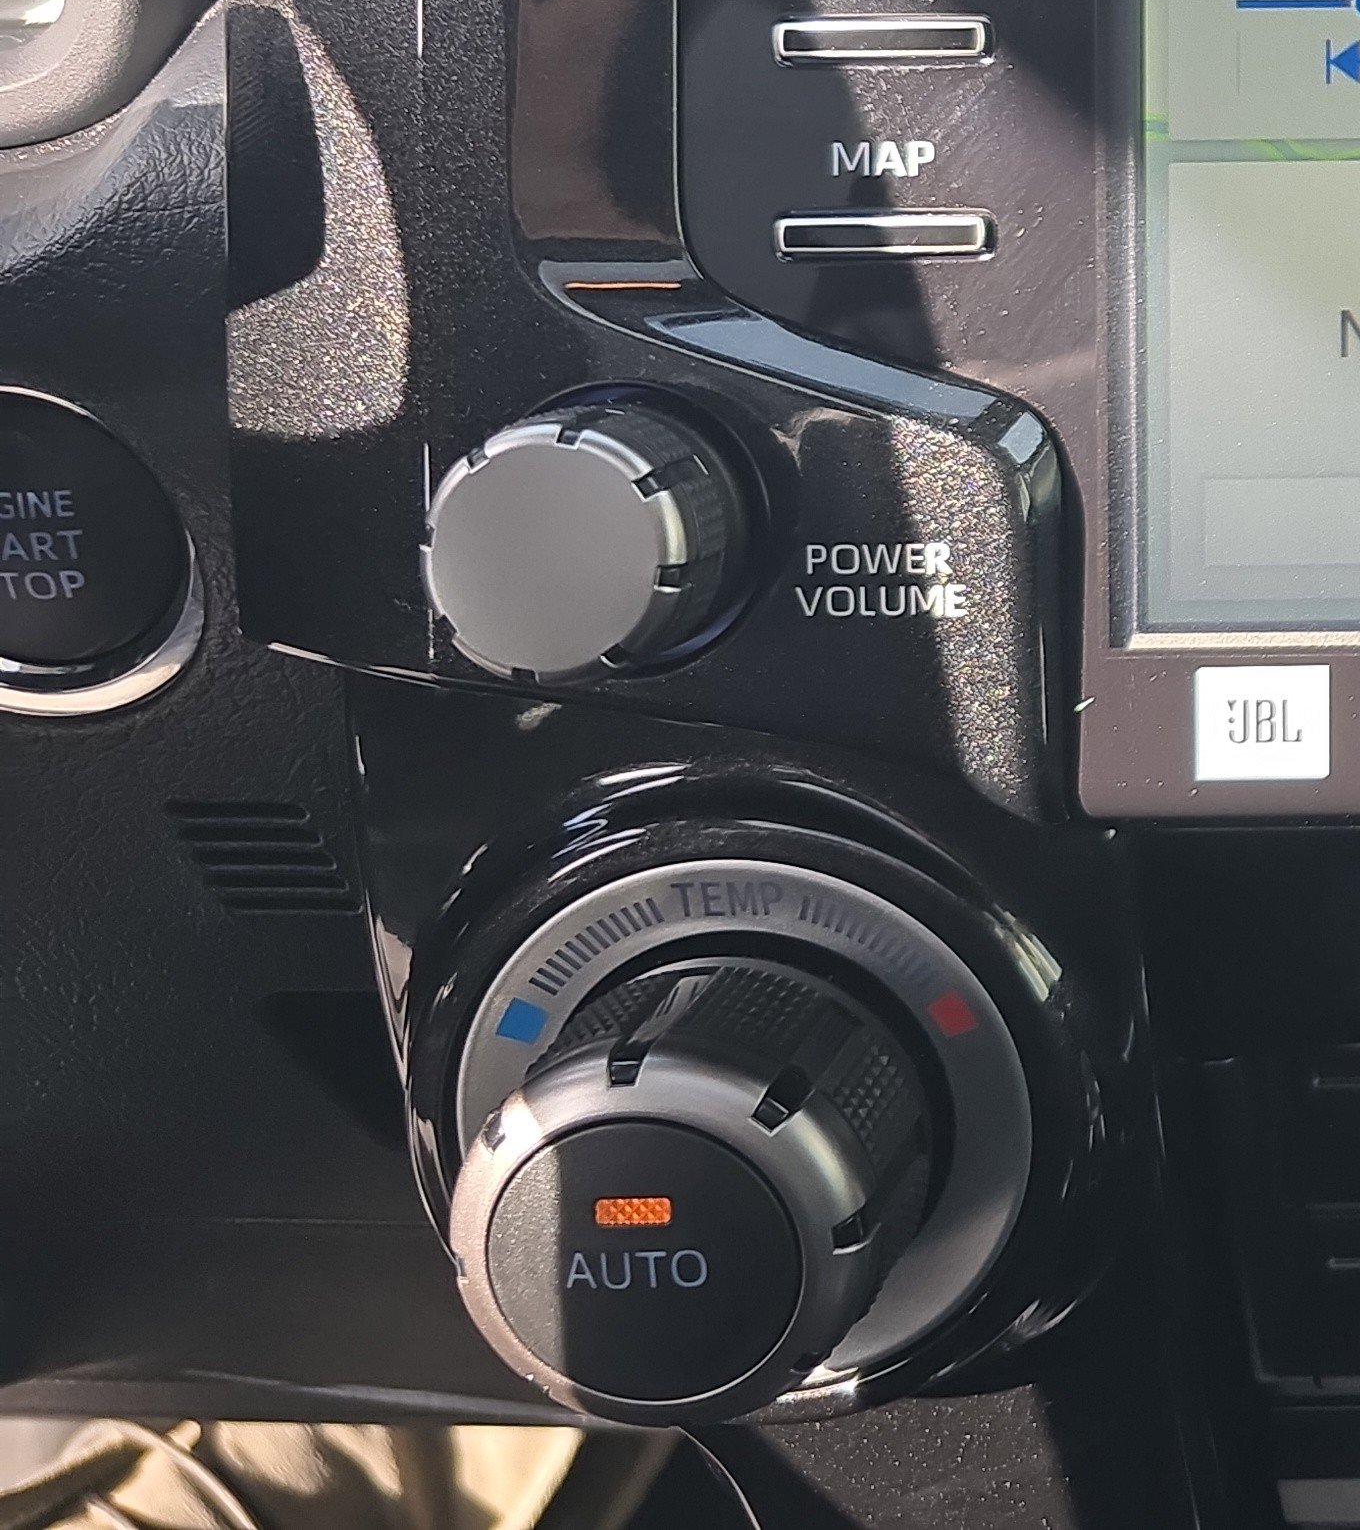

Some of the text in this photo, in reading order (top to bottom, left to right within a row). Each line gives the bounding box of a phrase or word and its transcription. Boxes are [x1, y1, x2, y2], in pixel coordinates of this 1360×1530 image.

[831, 141, 935, 178] MAP
[805, 542, 951, 575] POWER
[795, 583, 967, 619] VOLUME
[1228, 699, 1303, 744] JBL
[671, 882, 784, 918] TEMP
[566, 1250, 708, 1290] AUTO
